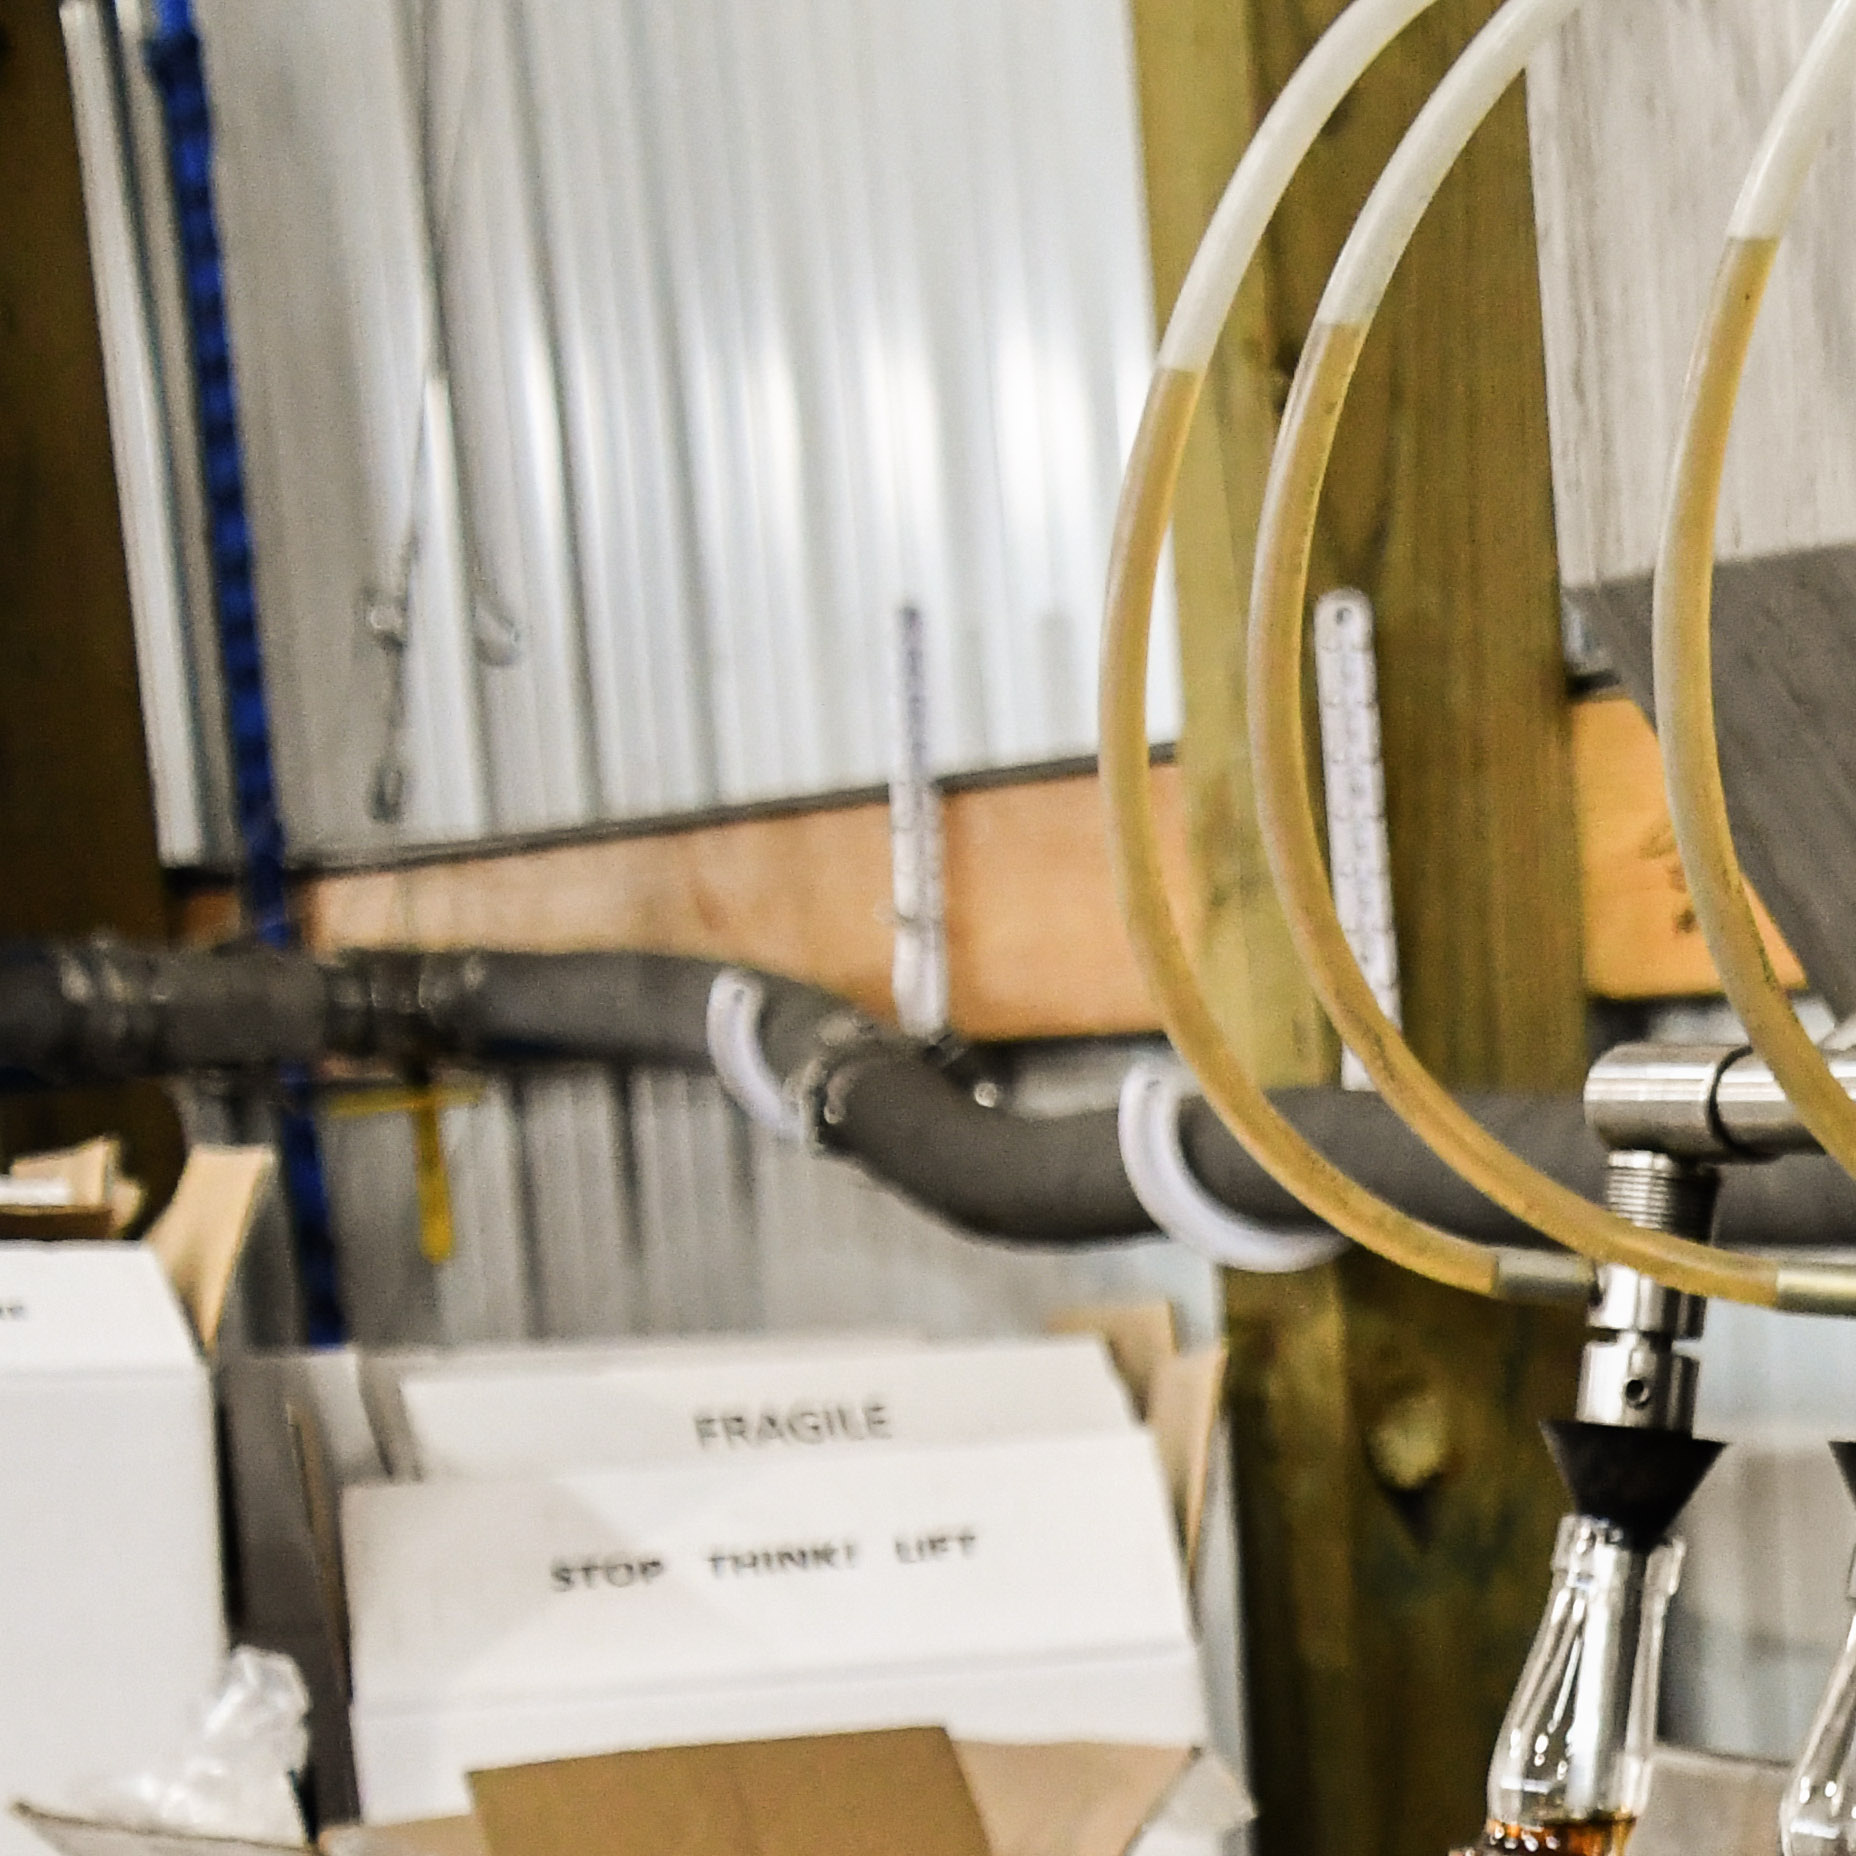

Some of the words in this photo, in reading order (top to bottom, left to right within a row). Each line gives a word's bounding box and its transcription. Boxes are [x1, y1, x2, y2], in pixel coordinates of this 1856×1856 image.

[694, 1401, 893, 1450] FRAGILE
[550, 1557, 665, 1592] STOP
[706, 1541, 860, 1580] THINK!
[895, 1525, 976, 1564] LIFT
